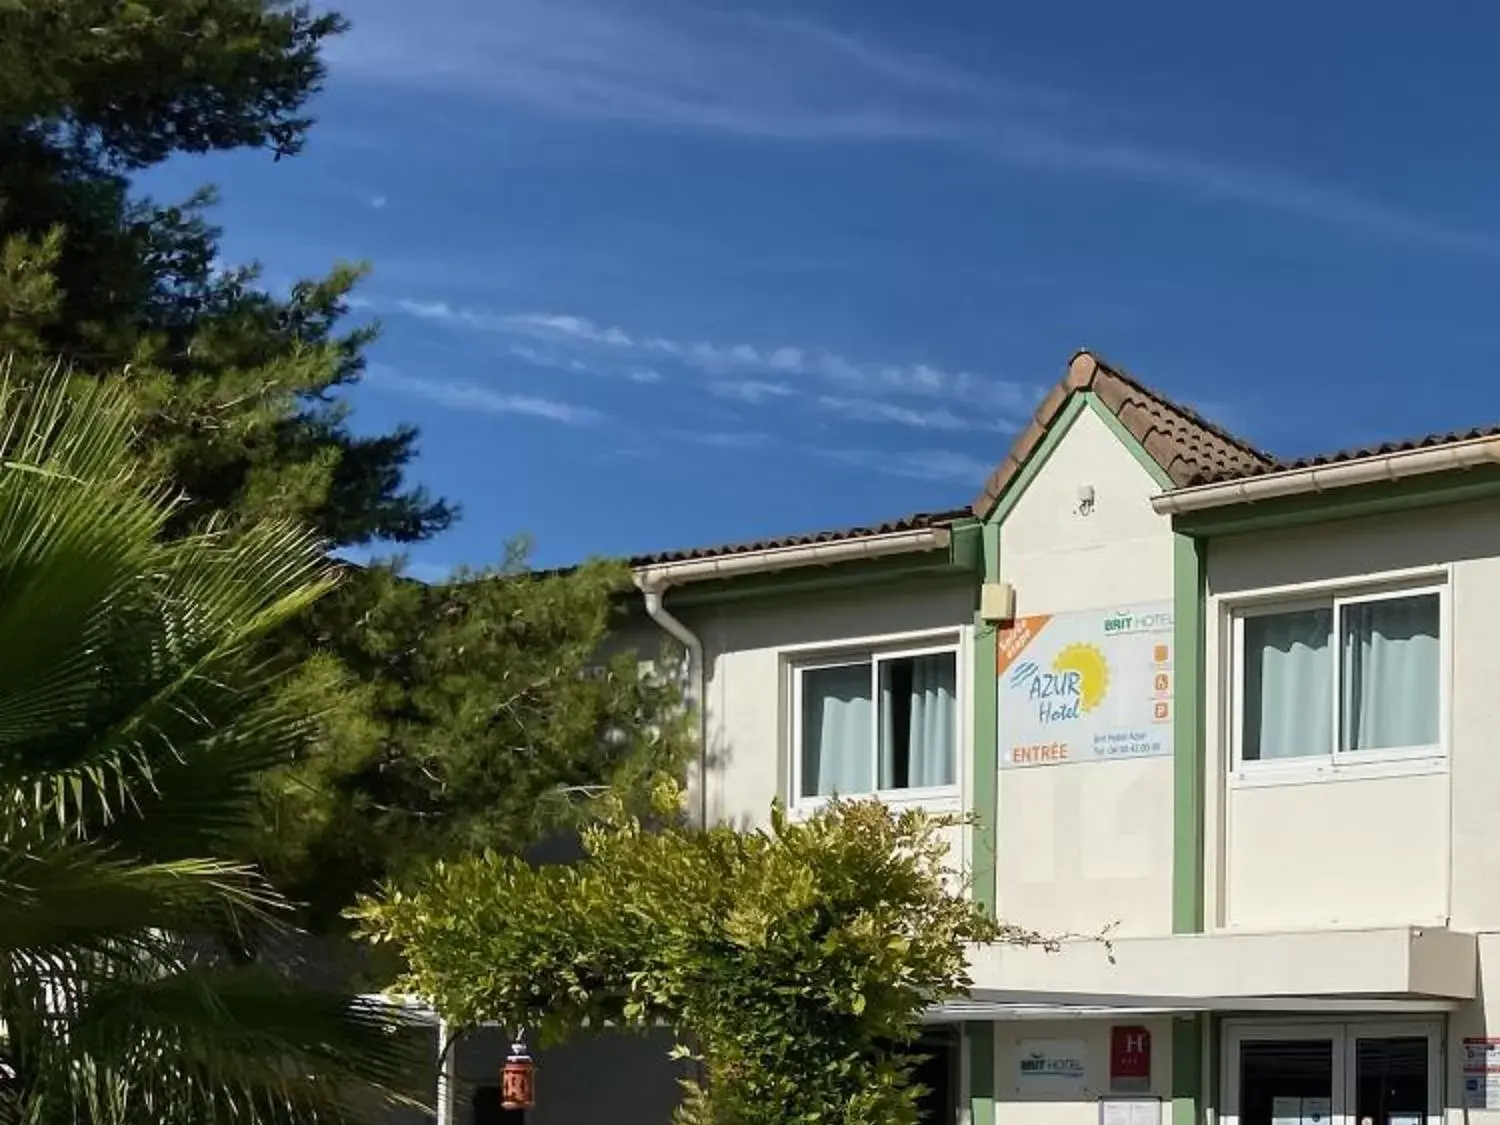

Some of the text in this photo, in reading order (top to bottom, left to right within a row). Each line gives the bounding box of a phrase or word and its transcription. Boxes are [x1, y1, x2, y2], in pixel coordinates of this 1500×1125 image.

[1104, 613, 1174, 631] BRIT HOTEL
[1029, 671, 1081, 700] AZUR
[1039, 698, 1080, 724] Hotel
[1012, 742, 1069, 763] ENTRÉE
[1126, 1033, 1143, 1053] H
